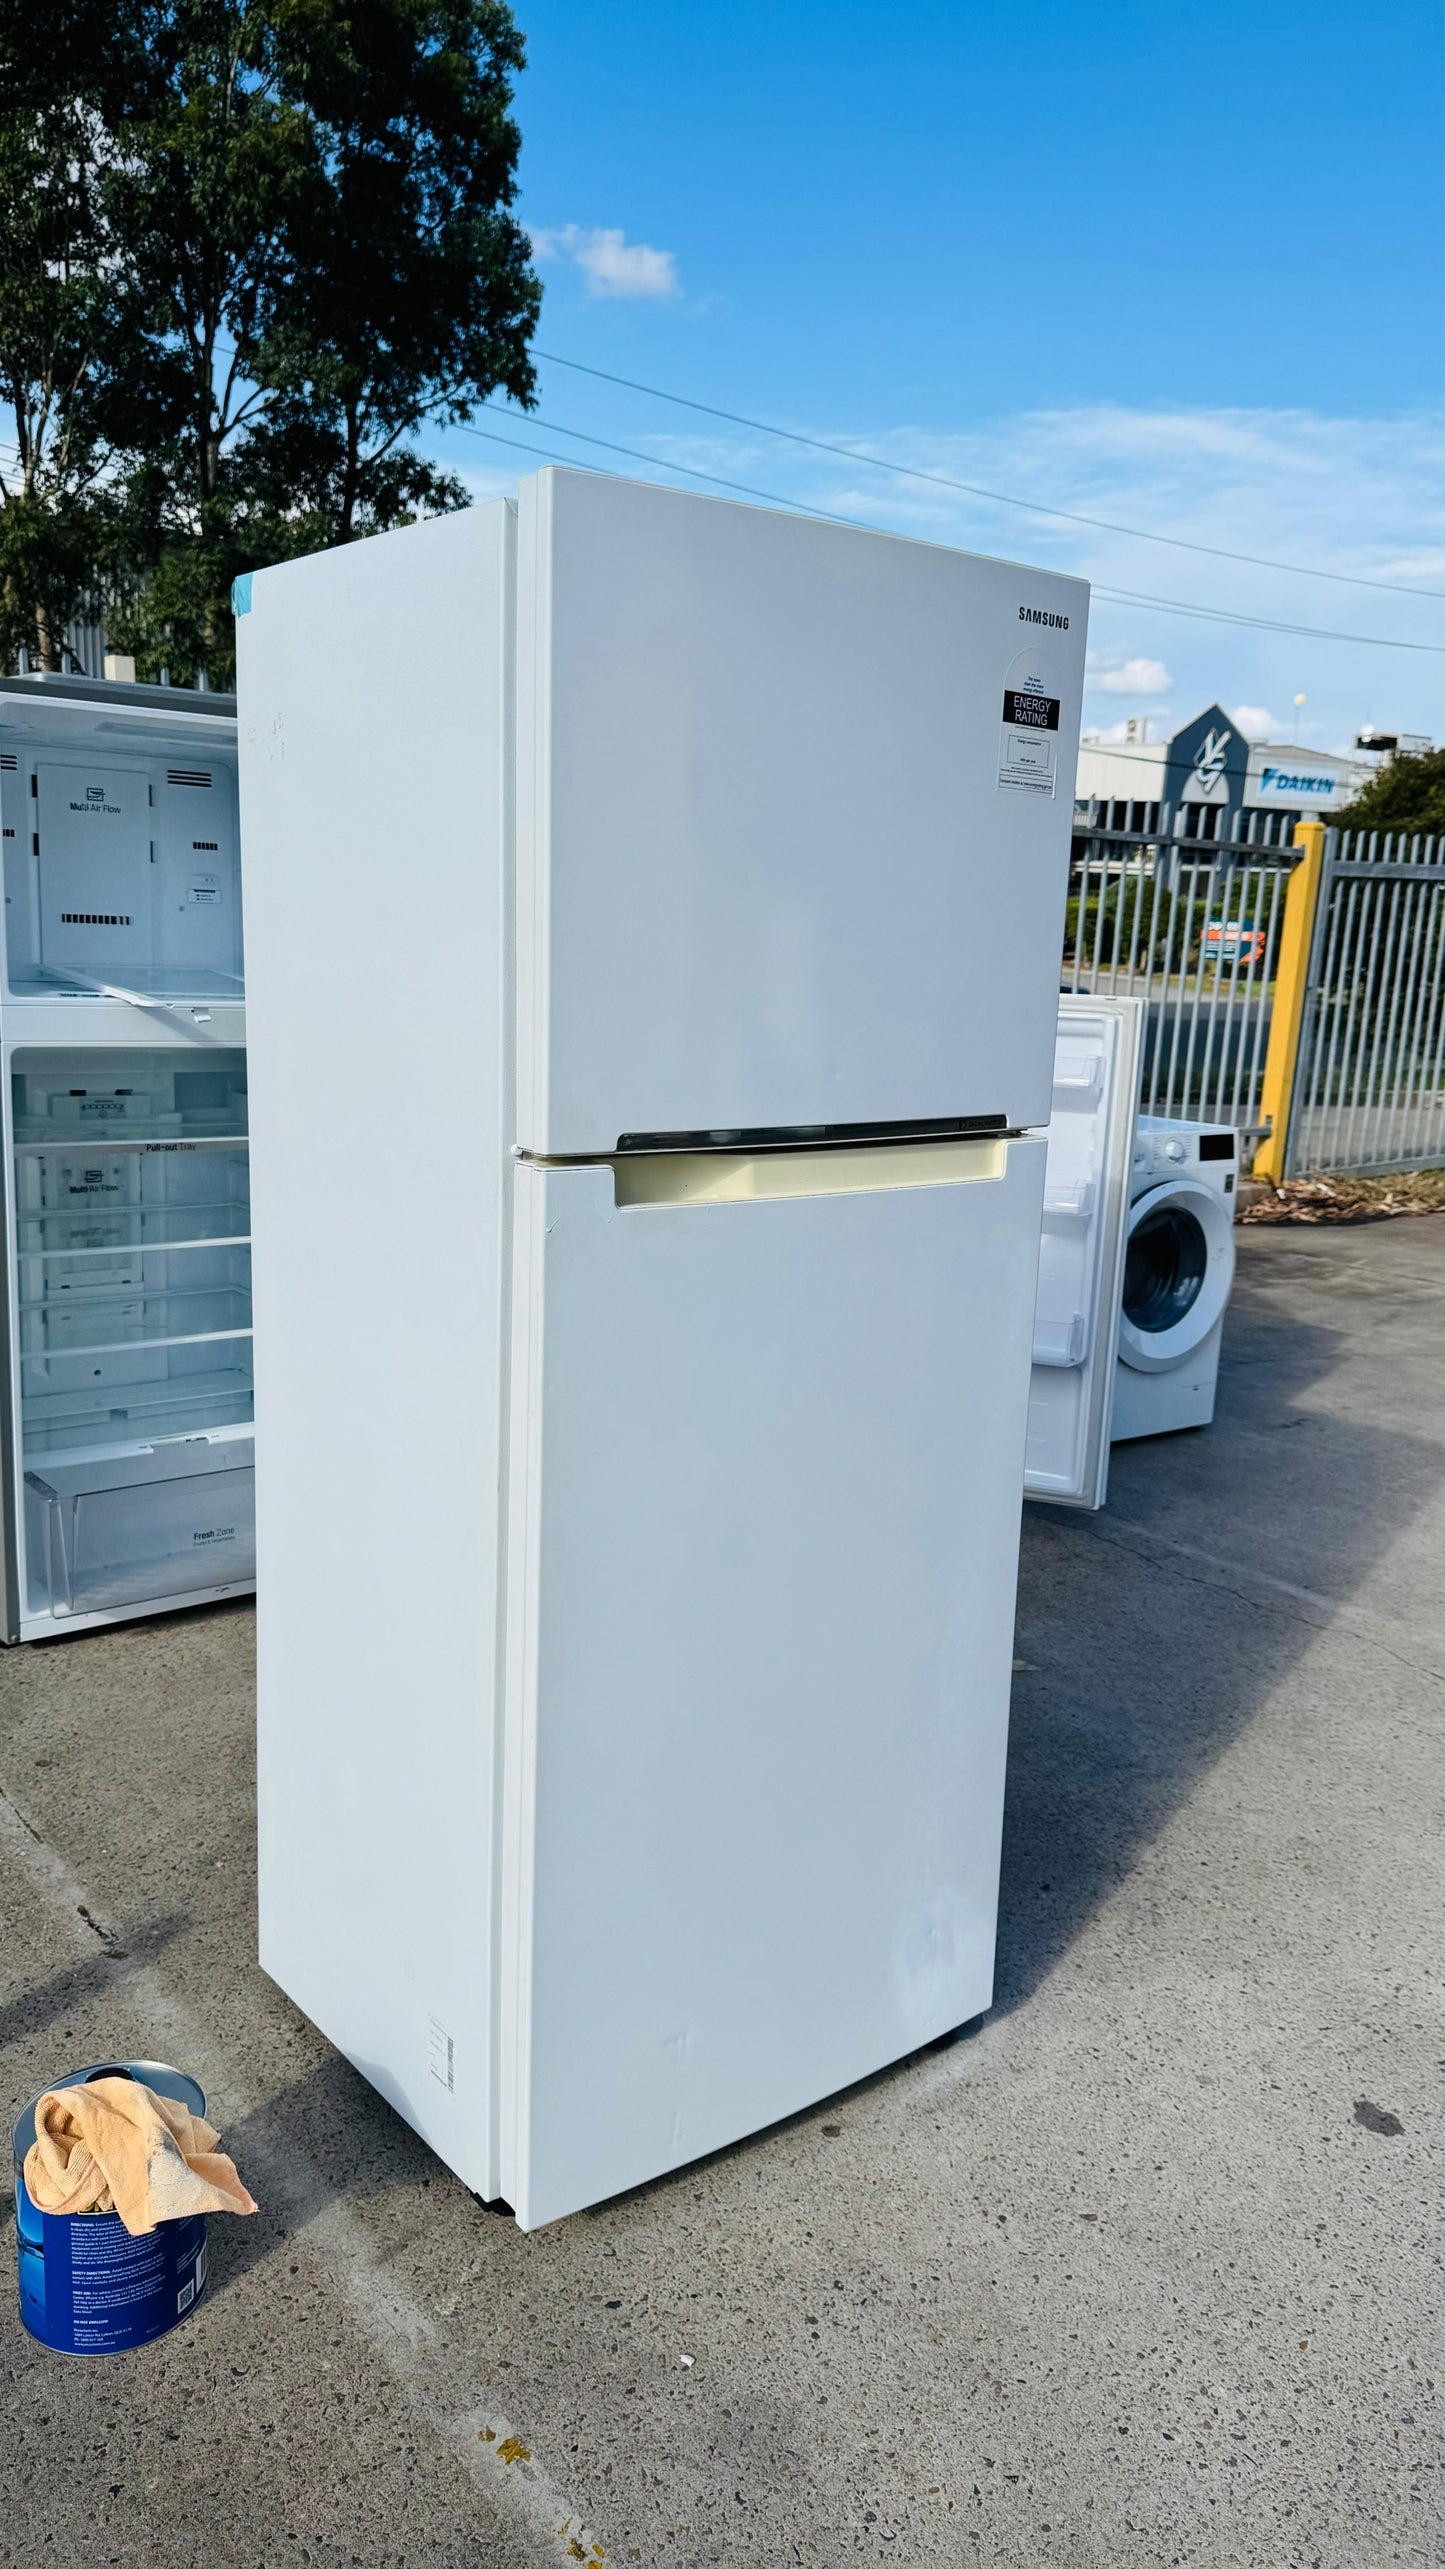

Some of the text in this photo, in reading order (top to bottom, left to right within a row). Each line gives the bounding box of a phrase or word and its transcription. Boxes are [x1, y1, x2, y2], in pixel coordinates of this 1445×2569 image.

[1019, 606, 1069, 630] SAMSUNG
[1014, 696, 1051, 712] ENERGY
[1015, 710, 1048, 726] RATING
[1277, 774, 1334, 794] DAIKIN
[70, 802, 121, 814] Multi Air Flow
[146, 1142, 196, 1152] Pull-out Tray
[194, 1528, 234, 1540] Fresh Zone
